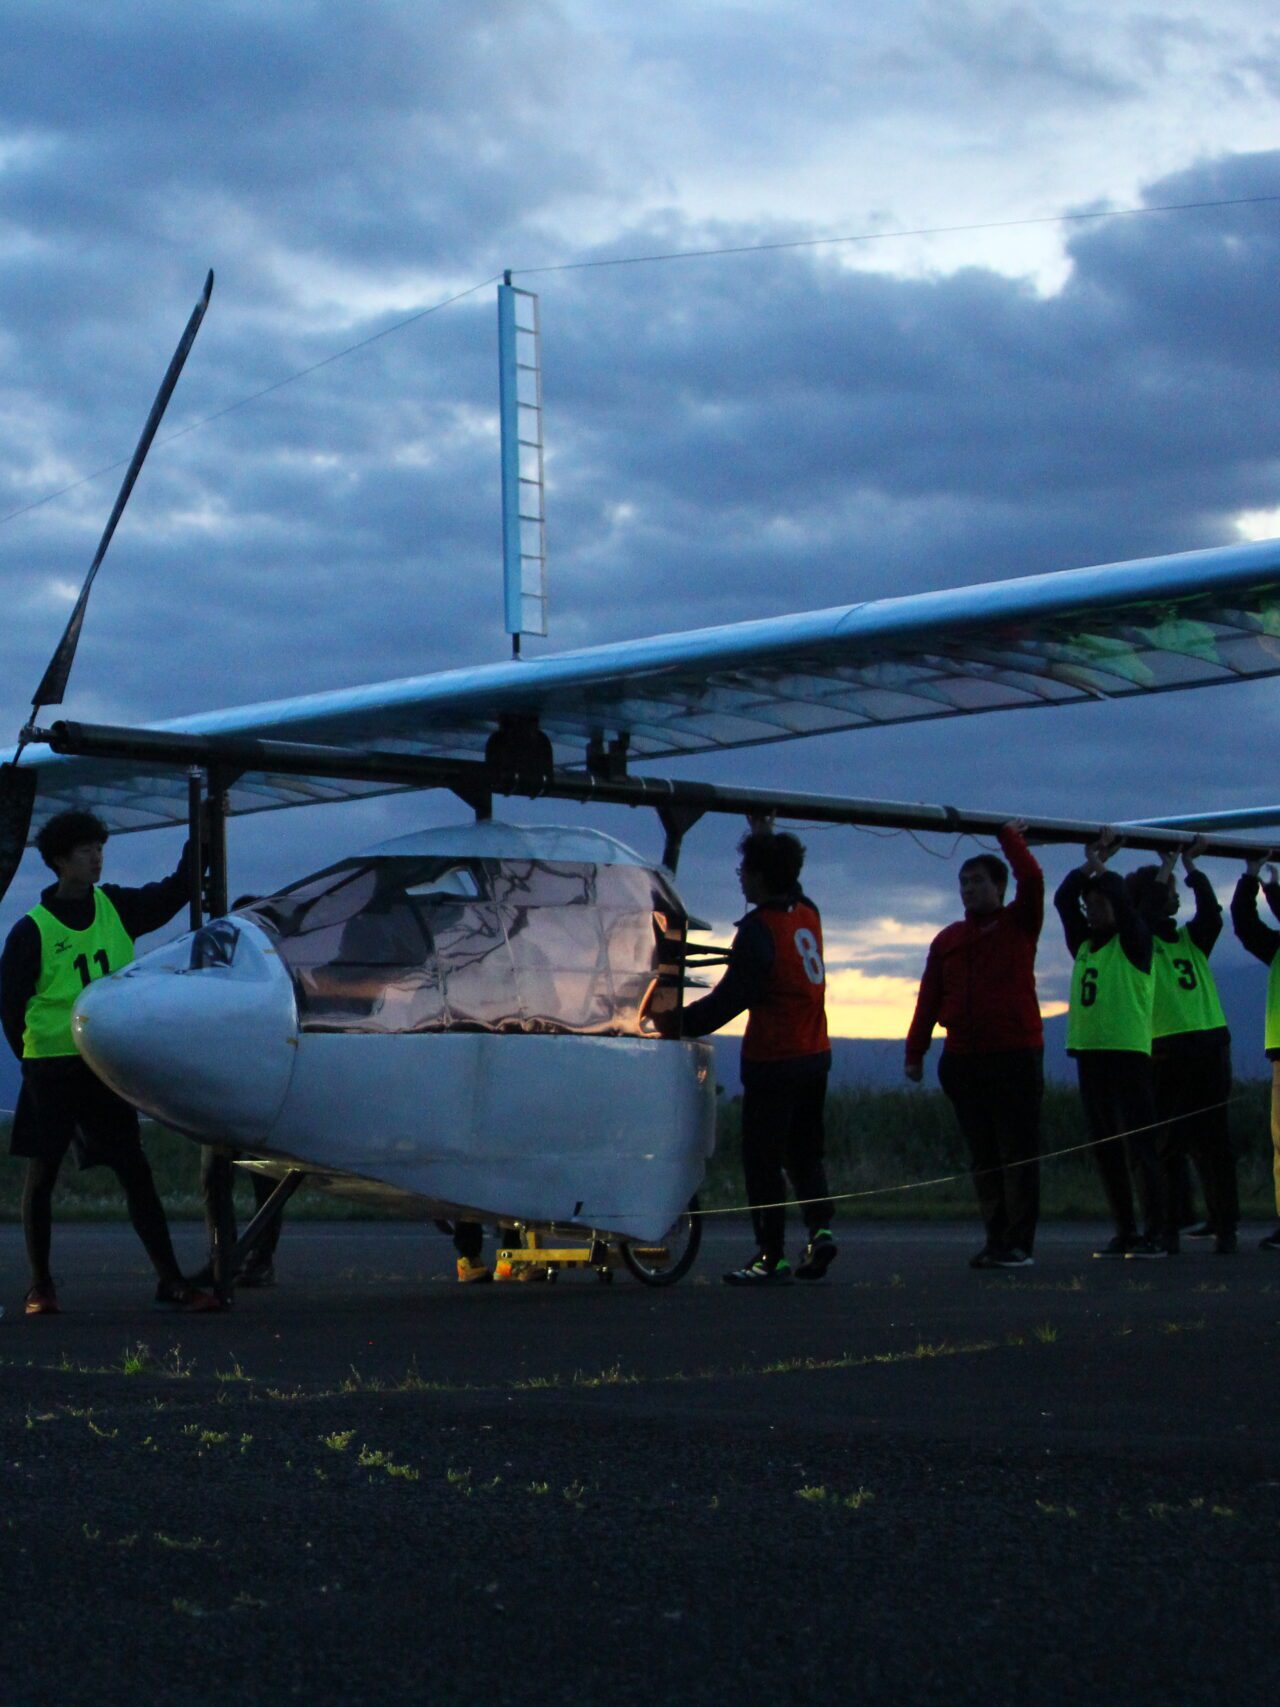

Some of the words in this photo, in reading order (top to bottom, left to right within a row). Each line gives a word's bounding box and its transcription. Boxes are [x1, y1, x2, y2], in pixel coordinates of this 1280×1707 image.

[73, 949, 110, 989] 11
[794, 928, 824, 985] 8
[1173, 959, 1197, 990] 3
[1081, 967, 1098, 1006] 6
